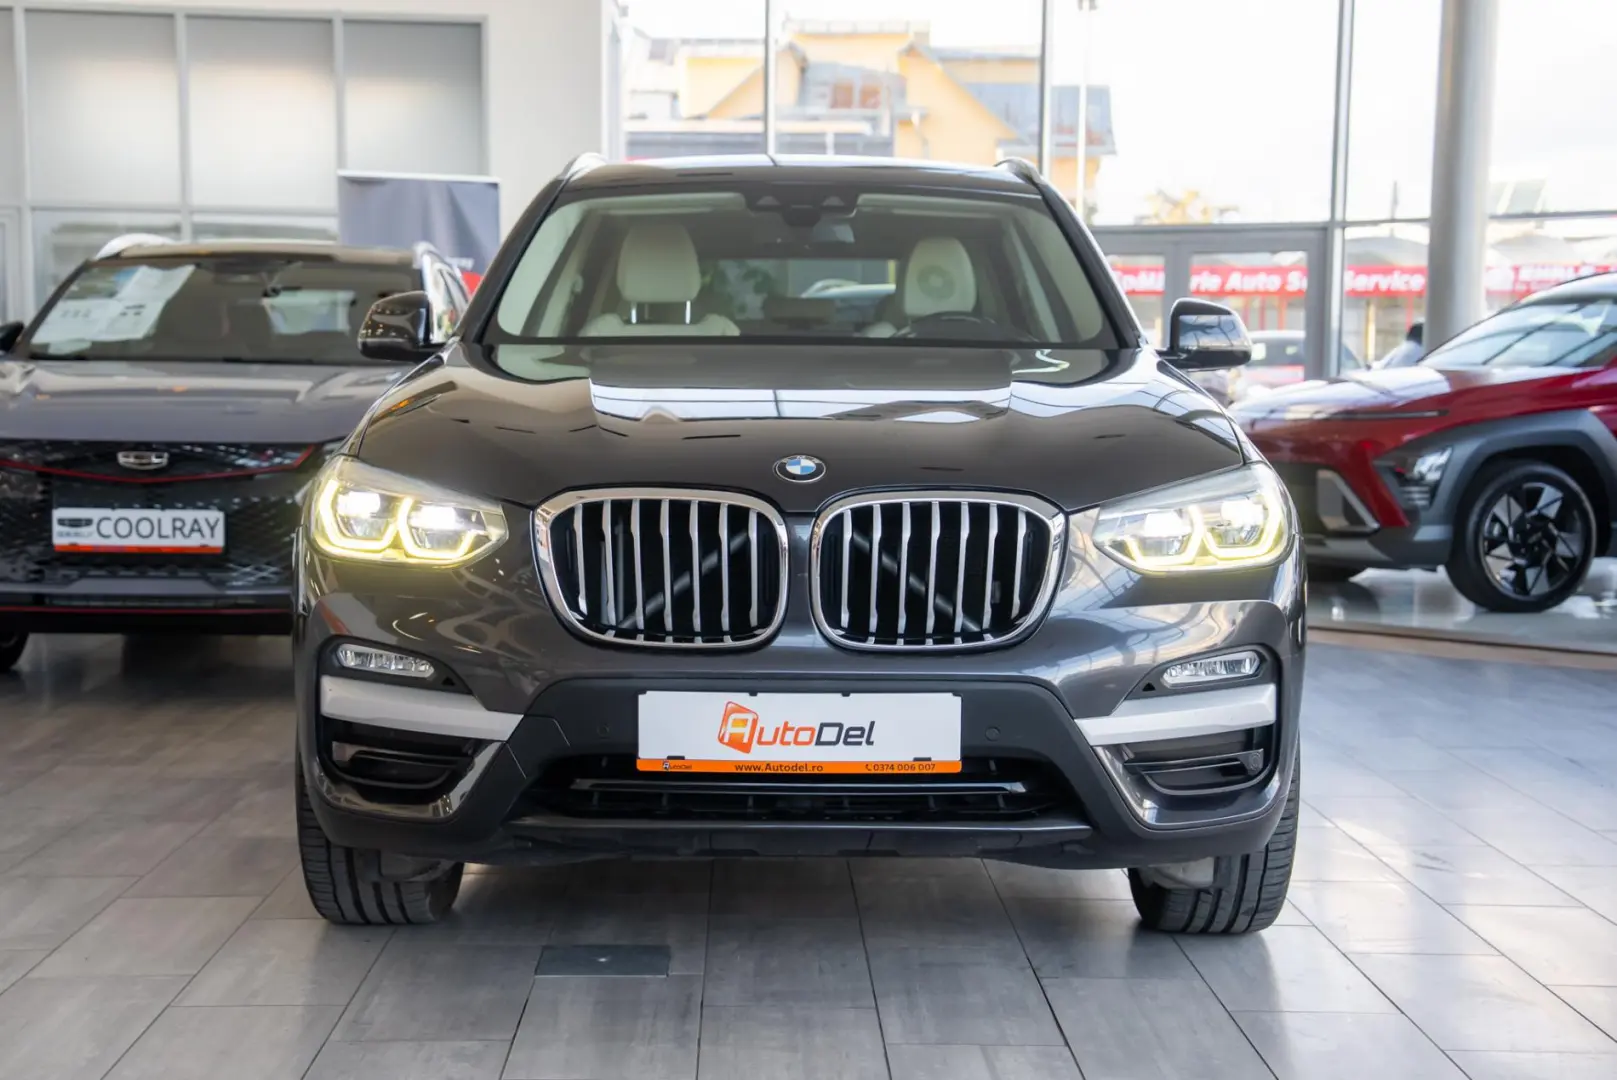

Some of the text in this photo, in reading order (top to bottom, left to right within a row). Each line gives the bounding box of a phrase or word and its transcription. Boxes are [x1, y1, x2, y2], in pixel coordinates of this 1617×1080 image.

[1224, 271, 1283, 292] Auto
[96, 516, 220, 539] COOLRAY
[719, 705, 876, 748] AutoDel
[734, 763, 824, 772] www.Autodel.ro
[873, 763, 895, 771] 0374
[897, 763, 916, 771] 006
[918, 763, 936, 771] 007
